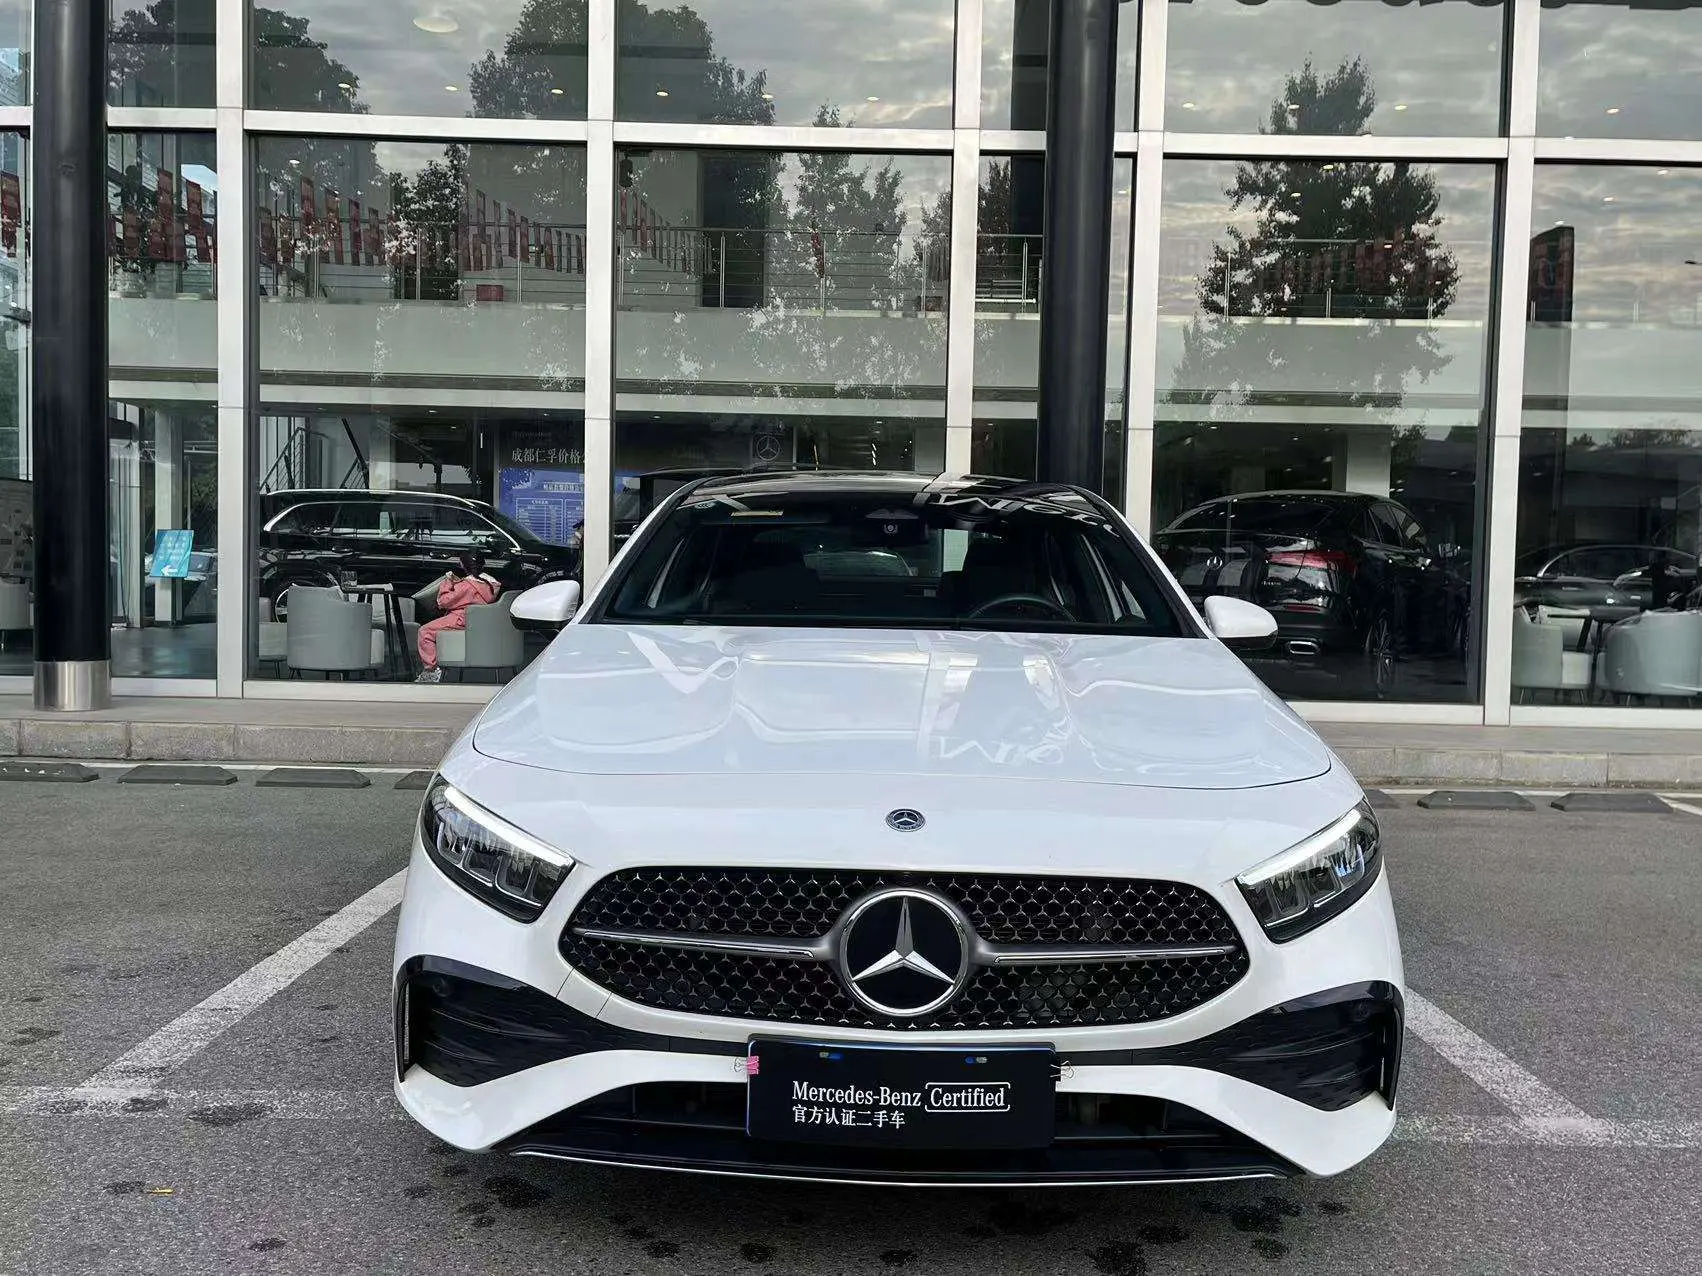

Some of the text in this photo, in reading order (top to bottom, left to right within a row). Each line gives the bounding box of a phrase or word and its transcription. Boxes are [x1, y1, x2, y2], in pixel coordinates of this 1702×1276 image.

[511, 447, 584, 464] 成都仁孚价格
[792, 1081, 1005, 1107] Mercedes-Benz Certified
[792, 1104, 906, 1129] 官方认证二手车
